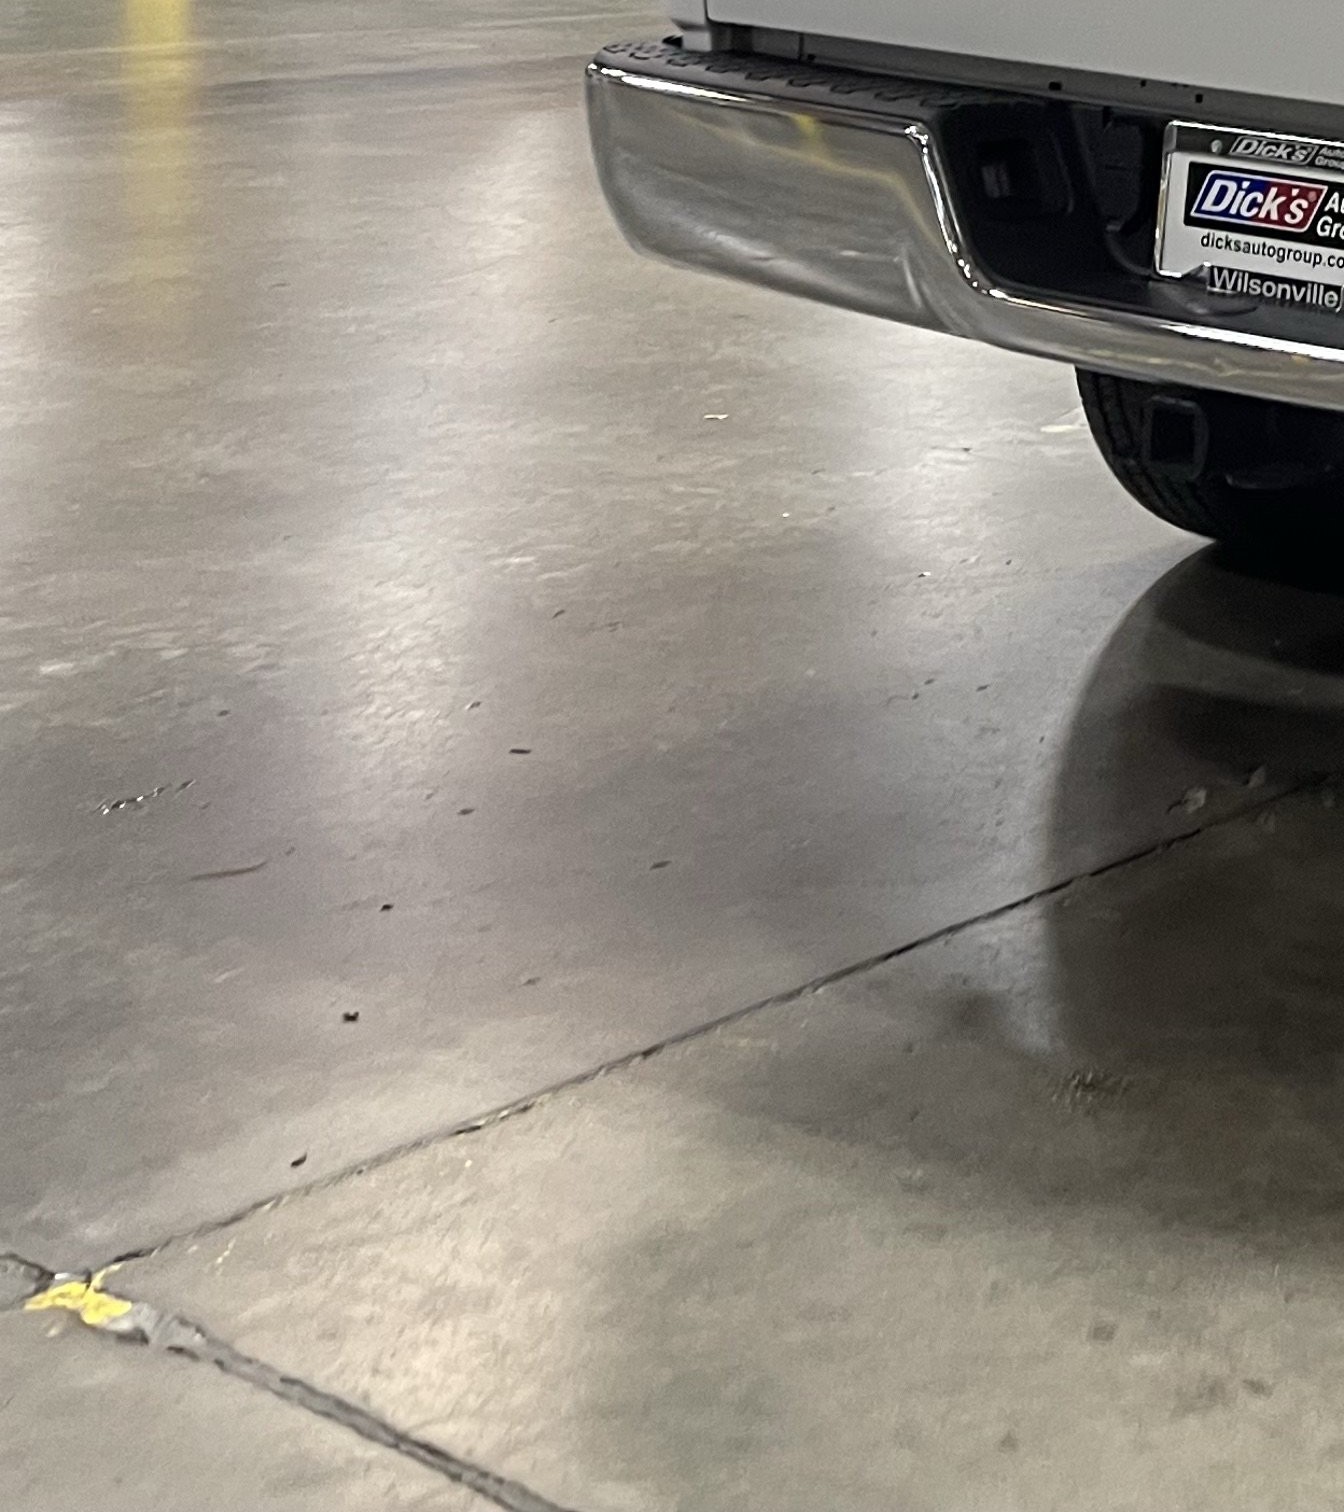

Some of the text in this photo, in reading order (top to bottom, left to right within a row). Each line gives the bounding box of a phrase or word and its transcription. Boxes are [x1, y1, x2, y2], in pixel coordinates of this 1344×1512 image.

[1234, 140, 1307, 162] Dick's
[1201, 179, 1308, 225] Dick's
[1213, 267, 1339, 307] Wilsonville
